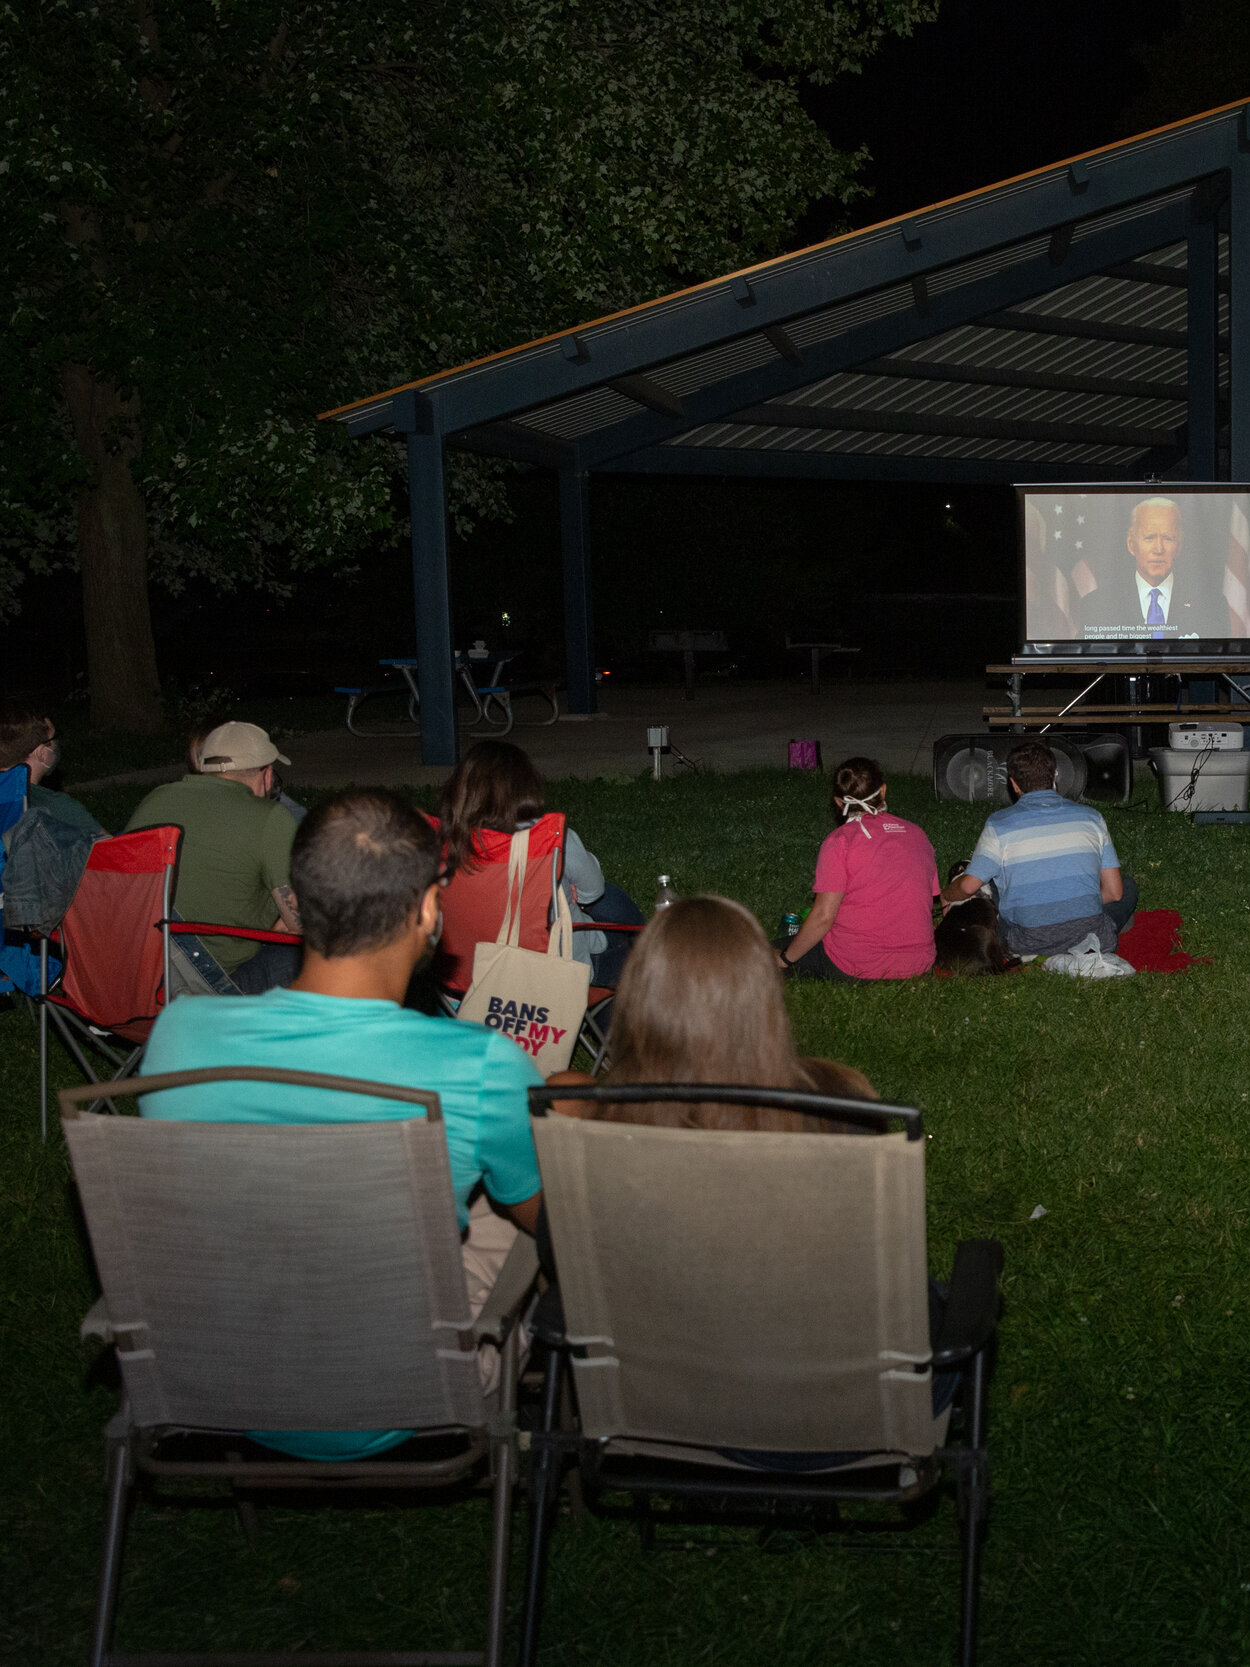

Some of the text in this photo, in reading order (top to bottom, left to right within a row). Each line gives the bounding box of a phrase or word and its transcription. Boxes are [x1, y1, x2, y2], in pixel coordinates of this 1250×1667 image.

[986, 750, 994, 797] BLACKMORE
[488, 996, 550, 1024] BANS
[484, 1014, 568, 1044] OFF MY
